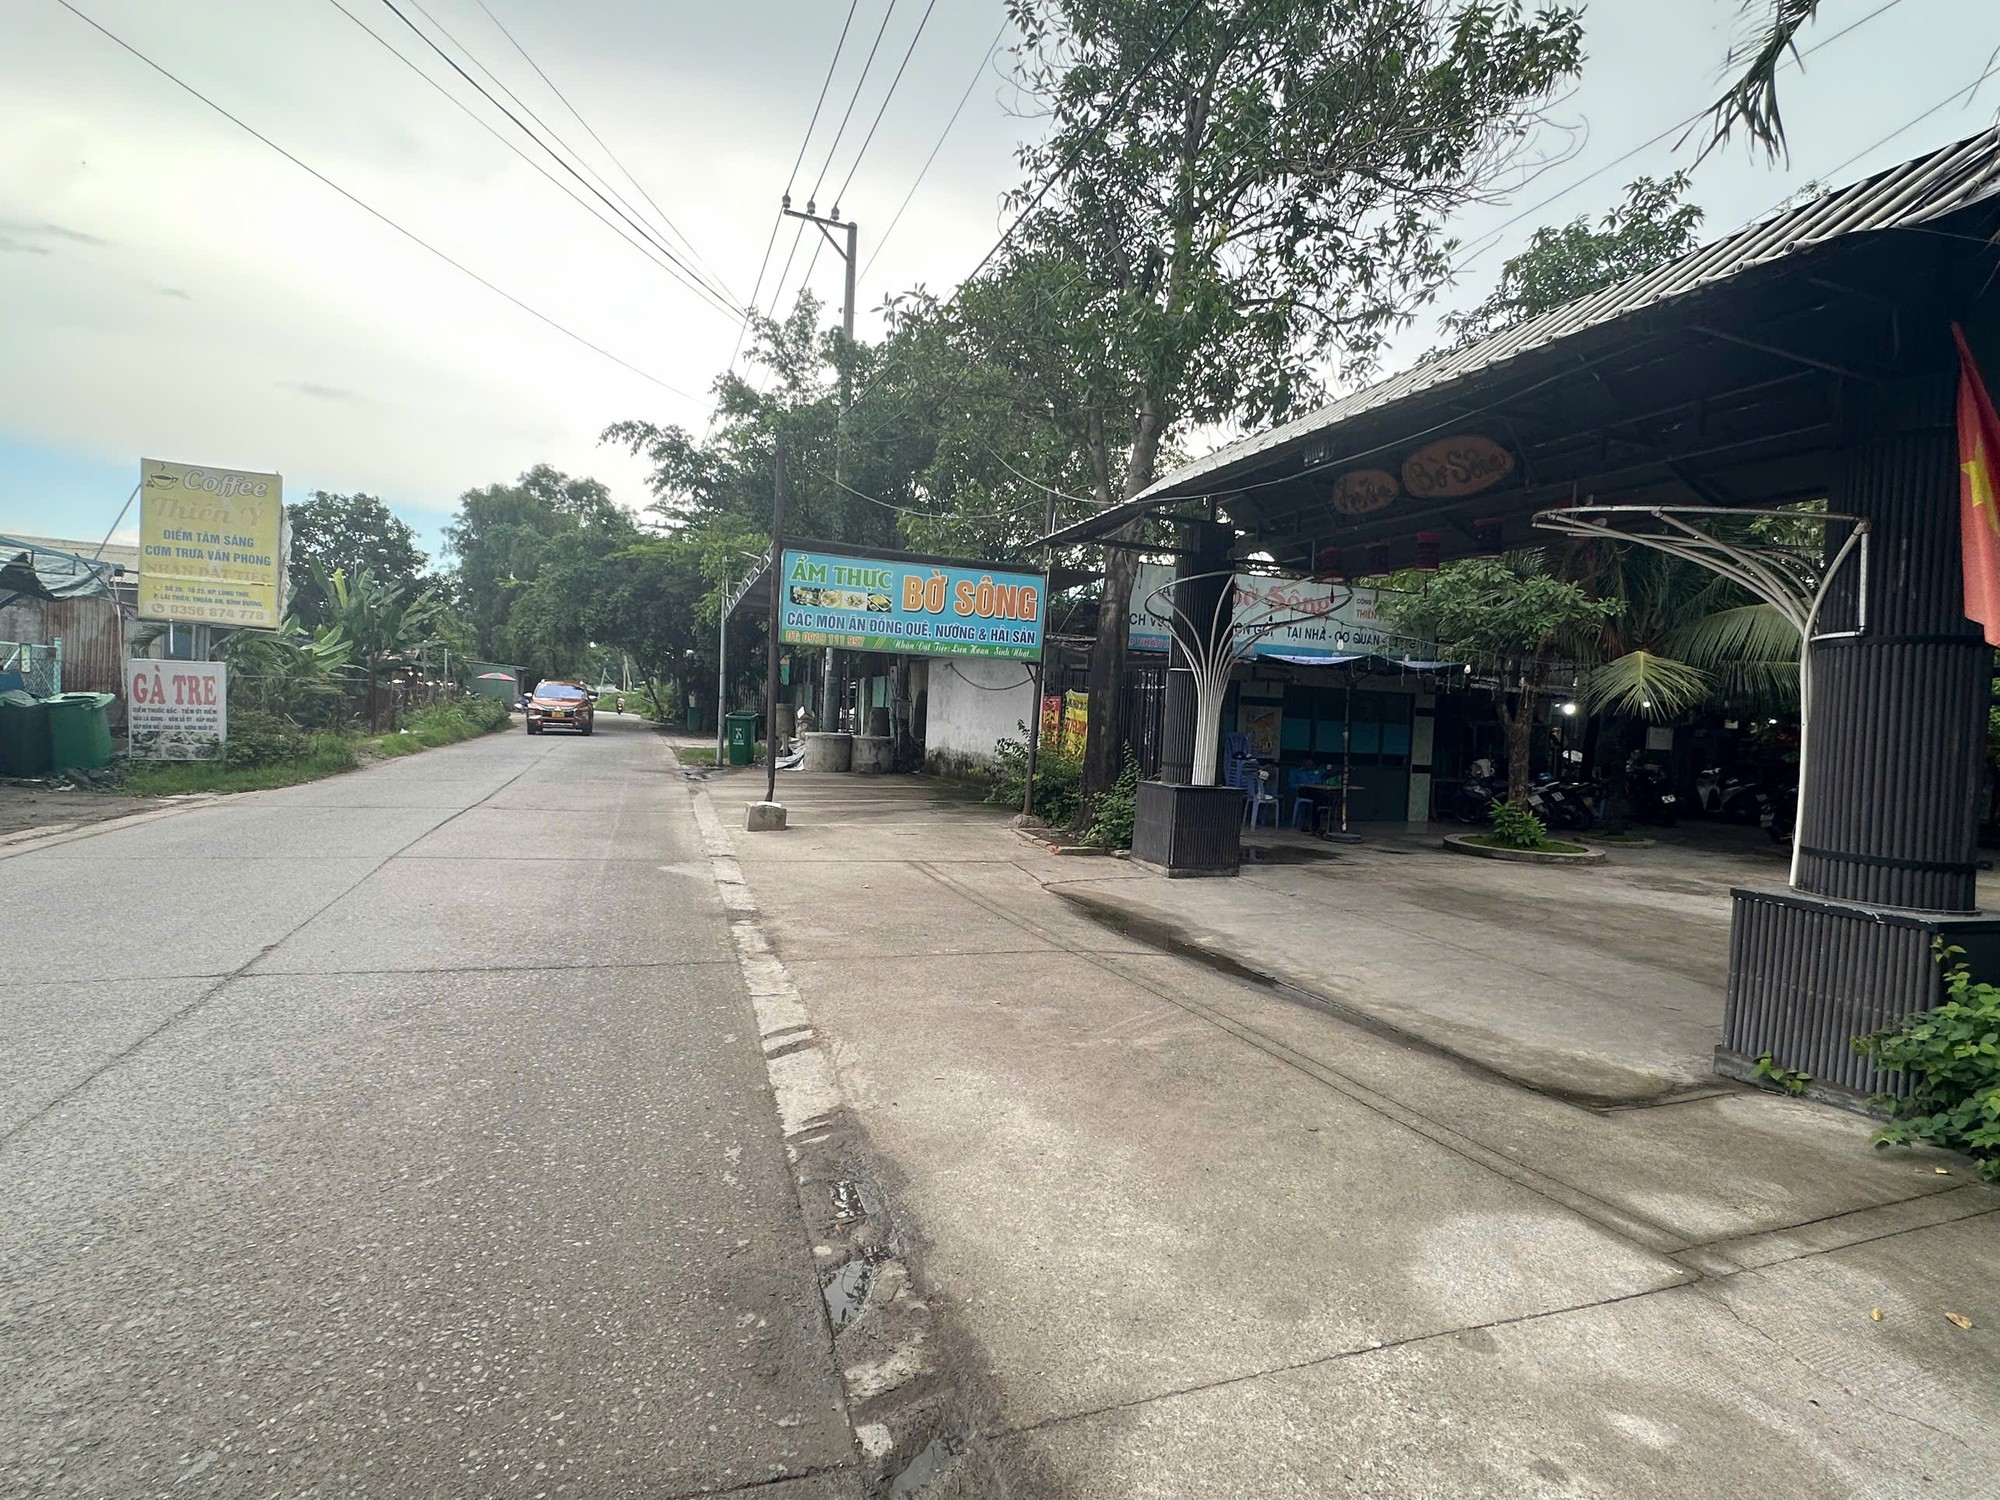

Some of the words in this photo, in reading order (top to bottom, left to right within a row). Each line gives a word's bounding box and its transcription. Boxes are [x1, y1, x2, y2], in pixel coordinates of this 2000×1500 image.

[183, 470, 268, 498] Coffee
[164, 527, 193, 542] ĐIỂM
[197, 531, 220, 544] TÂM
[224, 534, 255, 548] SÁNG
[145, 545, 172, 557] CƠM
[176, 547, 204, 560] TRƯA
[208, 548, 230, 562] VĂN
[234, 552, 272, 566] PHÒNG
[790, 554, 827, 584] ẨM
[833, 566, 893, 592] THỰC
[902, 569, 948, 615] BỜ
[953, 575, 1038, 622] SÔNG
[170, 605, 204, 616] 0356
[787, 611, 812, 627] CÁC
[817, 613, 846, 630] MÓN
[849, 616, 866, 632] ĂN
[870, 616, 902, 634] ĐỒNG
[906, 620, 931, 638] QUÊ,
[935, 623, 975, 640] NƯỚNG
[978, 629, 988, 641] &
[990, 625, 1009, 643] HẢI
[1012, 626, 1036, 645] SẢN
[1287, 626, 1301, 642] TẠI
[1305, 627, 1326, 642] NHÀ
[133, 664, 167, 704] GÀ
[172, 675, 217, 706] TRE
